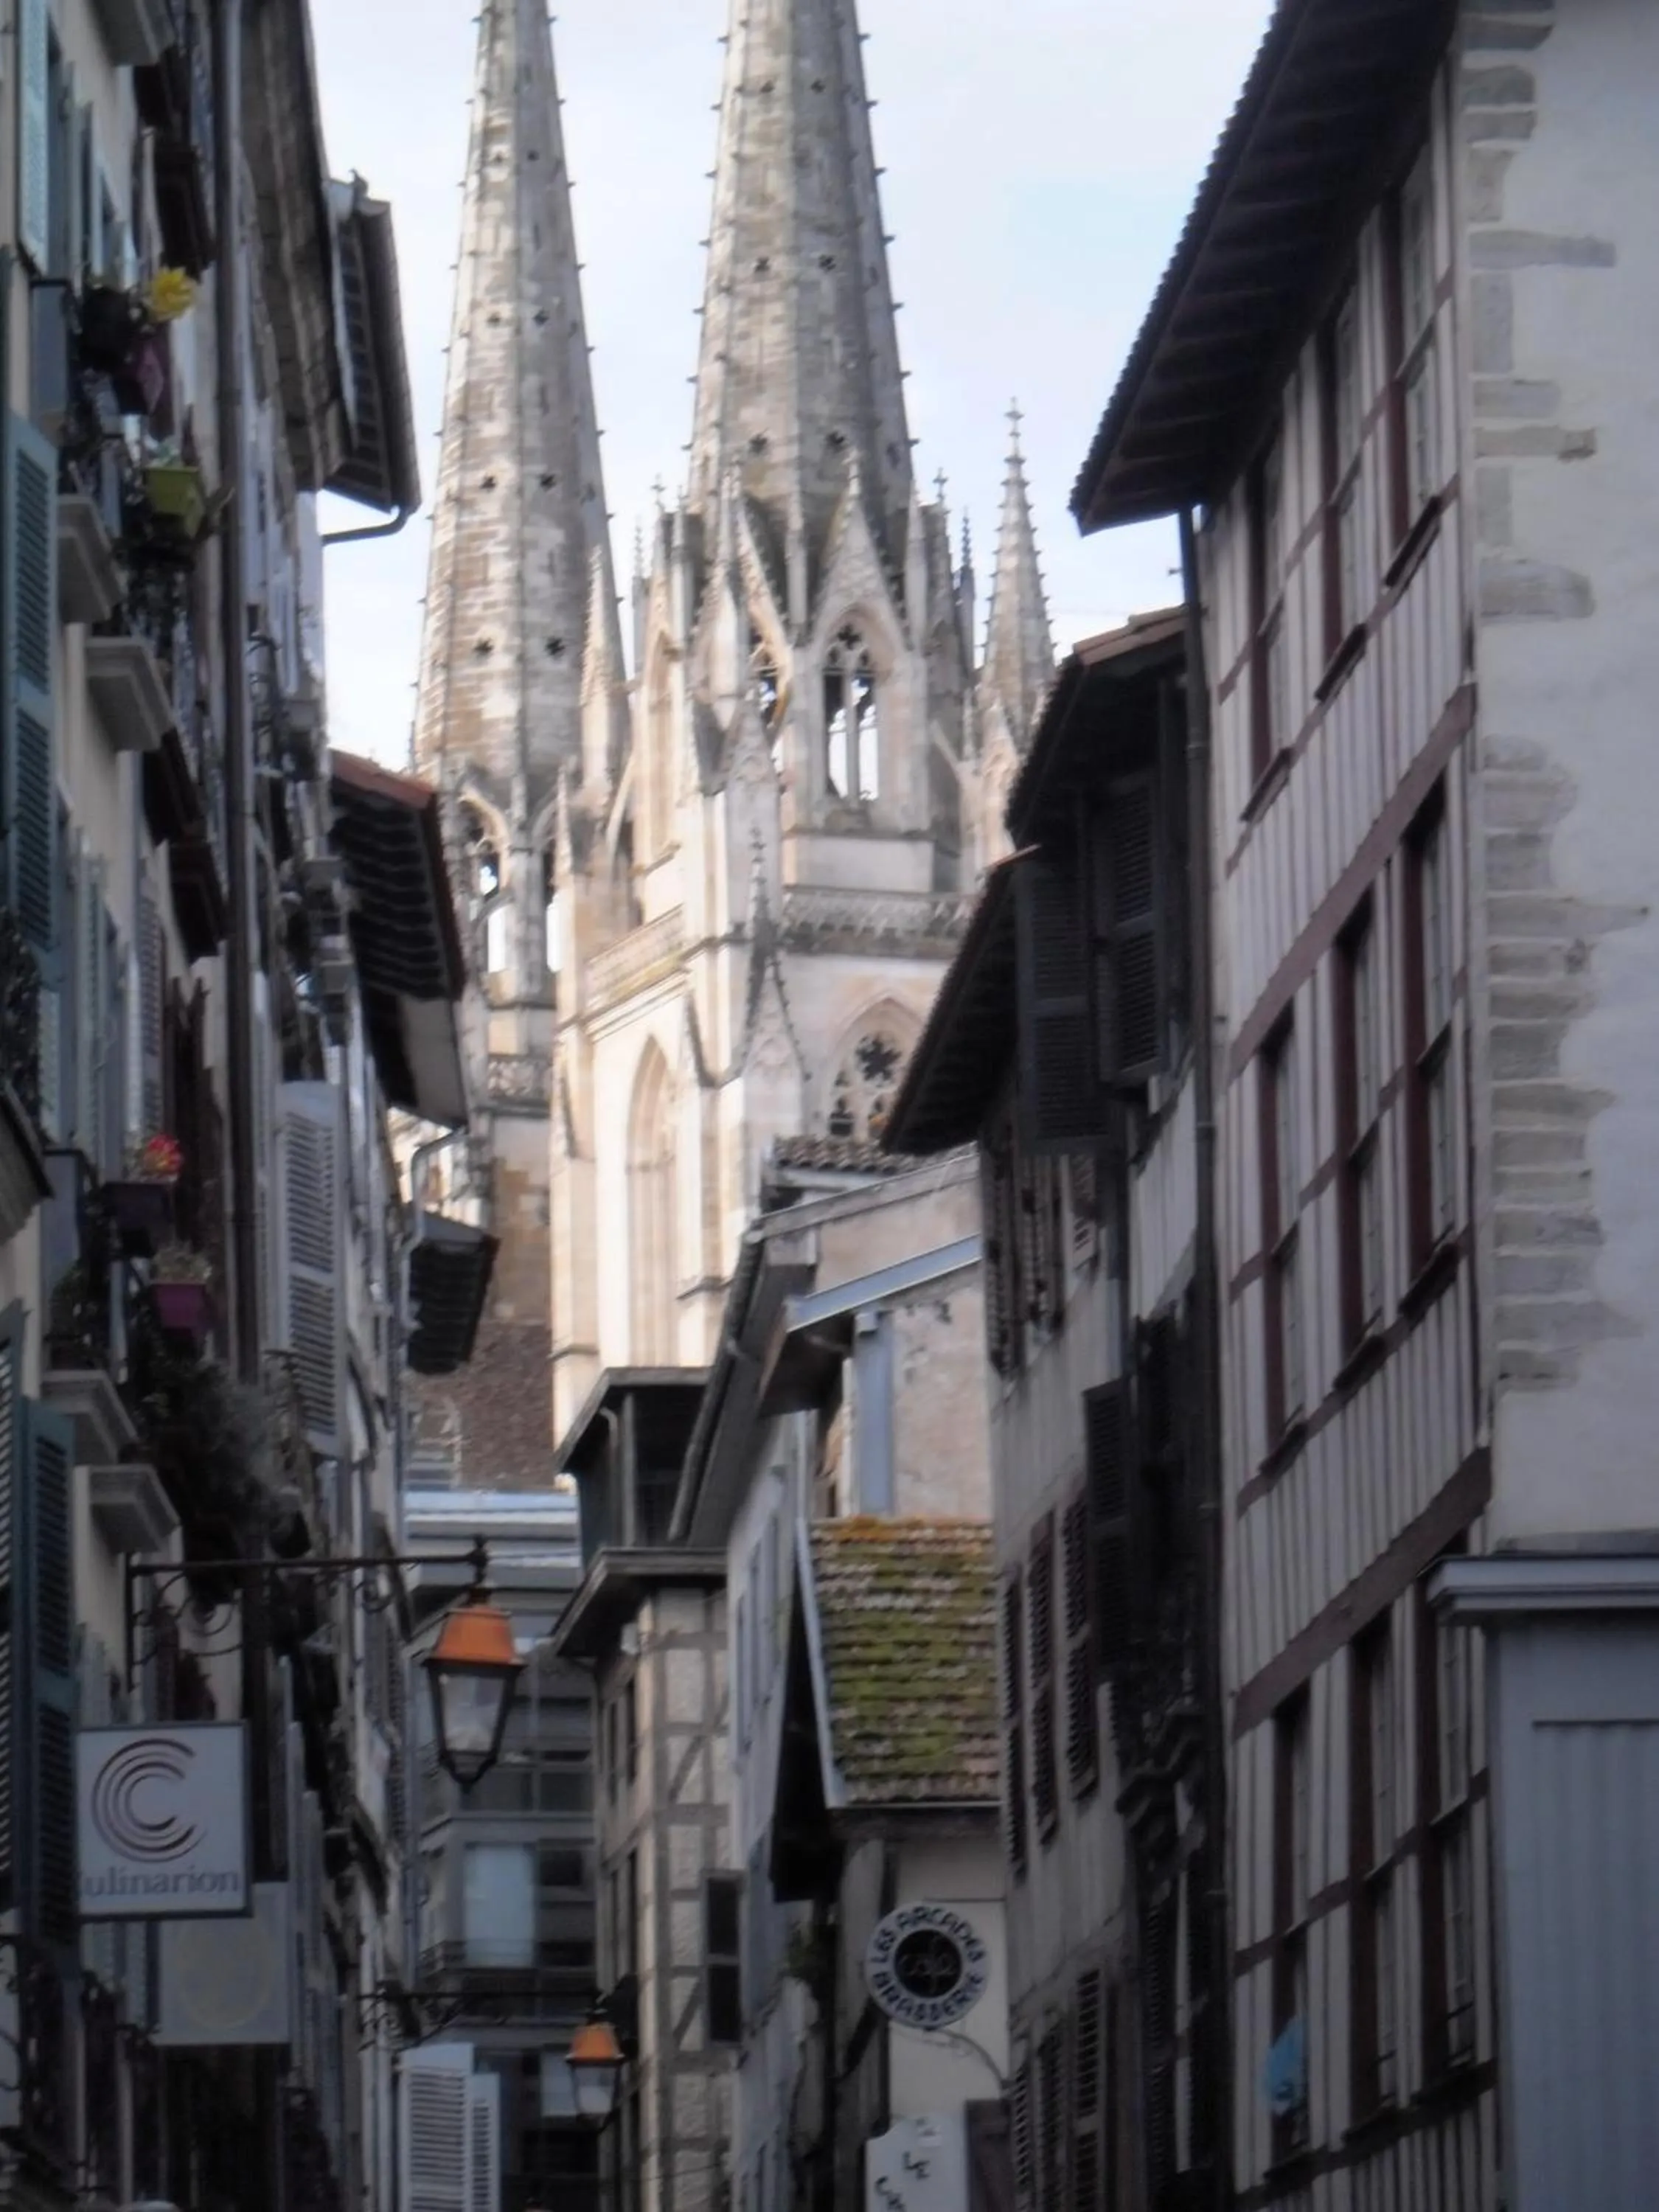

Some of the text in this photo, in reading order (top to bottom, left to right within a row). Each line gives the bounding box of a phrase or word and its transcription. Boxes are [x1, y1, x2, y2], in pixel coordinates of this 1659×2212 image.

[75, 1865, 239, 1896] ulinarion
[871, 1905, 986, 1964] LES ARCADES
[872, 1972, 984, 2022] BRASSERIE
